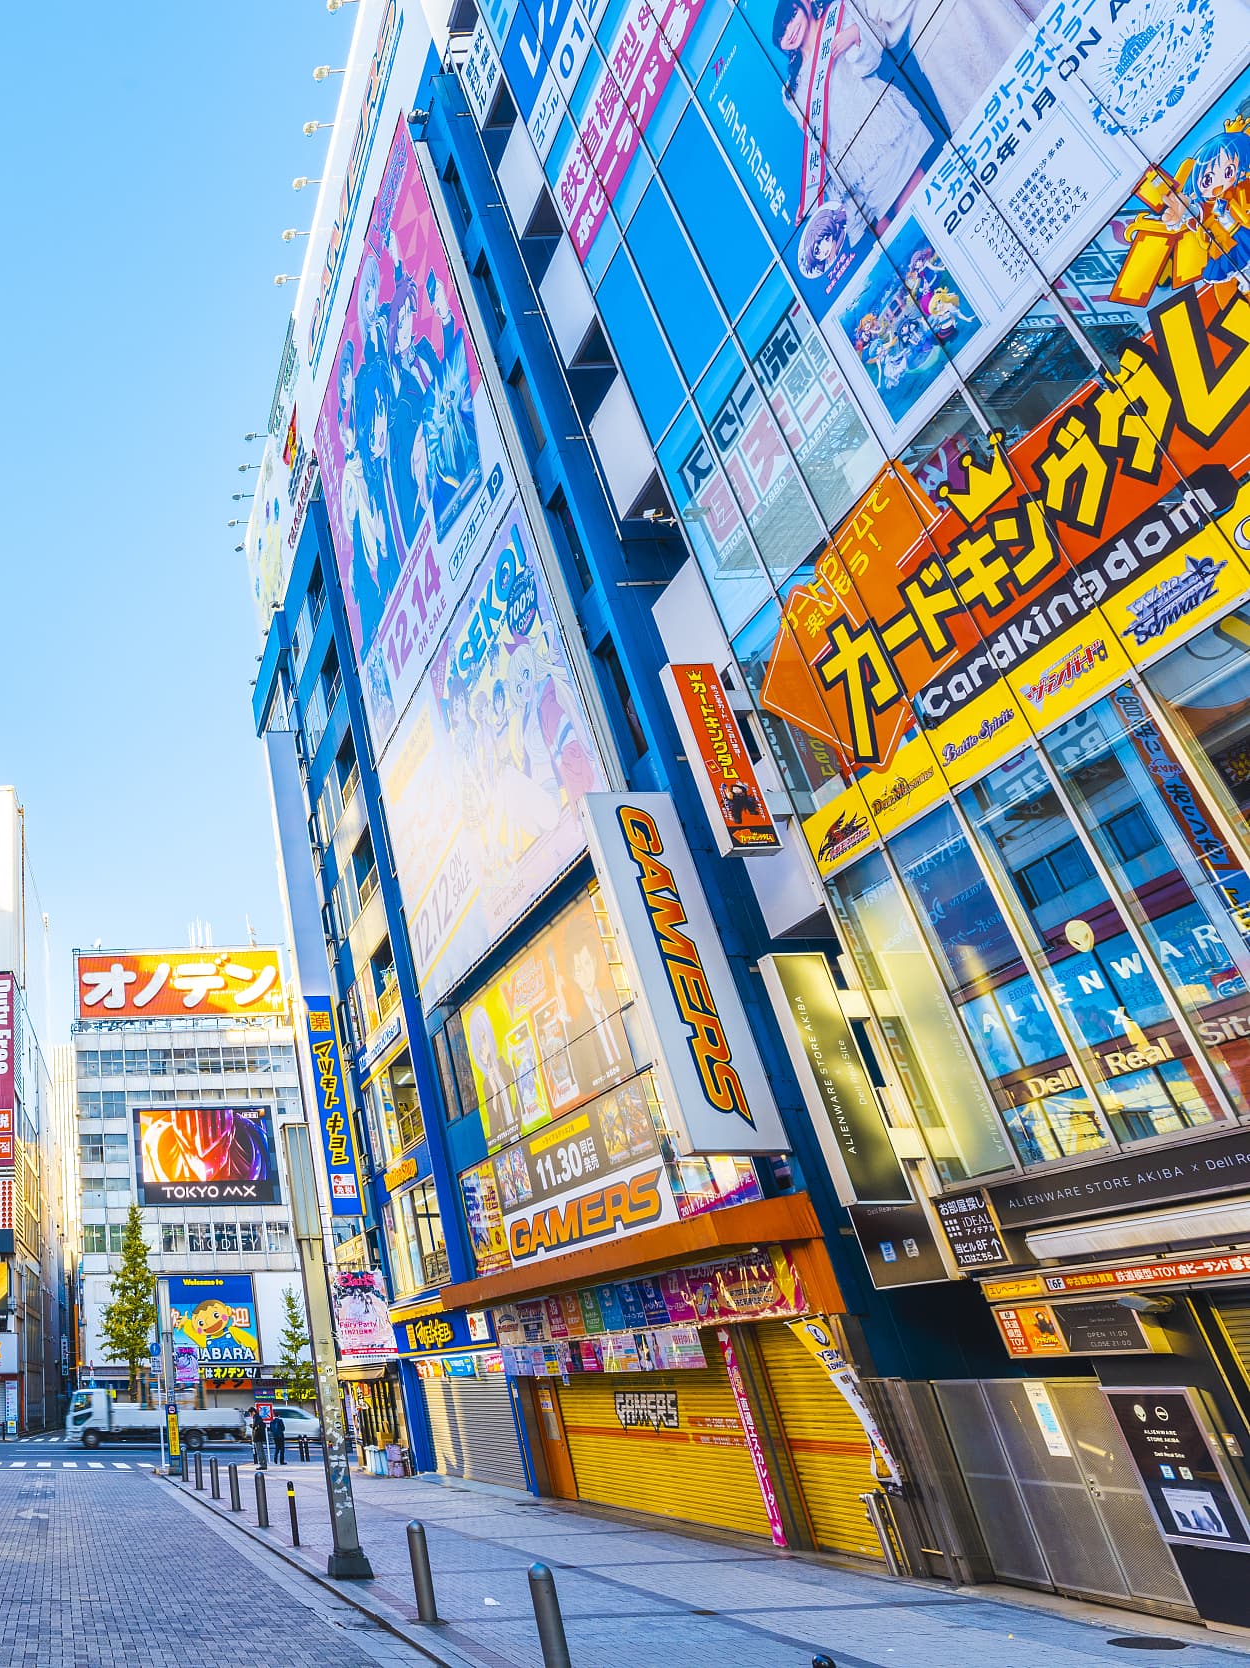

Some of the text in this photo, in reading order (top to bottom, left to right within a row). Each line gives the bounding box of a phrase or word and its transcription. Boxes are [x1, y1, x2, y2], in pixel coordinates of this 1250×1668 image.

[944, 86, 1057, 236] 2019年1月
[1058, 26, 1102, 82] ON
[386, 545, 443, 679] 12.14
[506, 578, 537, 625] 100%
[417, 597, 447, 655] ON SALE
[691, 679, 740, 780] カードキングダム
[977, 708, 1015, 741] Spirits
[451, 862, 473, 903] SALE
[414, 889, 451, 969] 12.12
[81, 952, 277, 1009] オノデン
[616, 804, 757, 1132] GAMERS
[794, 995, 857, 1154] ALIENWARE STORE AKIBA
[1025, 1067, 1080, 1099] Dell
[1105, 1037, 1175, 1075] Real
[535, 1141, 582, 1191] 11.30
[1009, 1156, 1234, 1209] ALIENWARE STORE AKIBA Dell
[161, 1185, 257, 1199] TOKYO MX
[508, 1168, 663, 1263] GAMERS
[938, 1196, 985, 1216] お部屋探し
[193, 1237, 259, 1251] MODIFY
[961, 1213, 992, 1227] iDEAL
[955, 1239, 988, 1254] 当ビル8F
[959, 1252, 994, 1264] 入口はこちら
[340, 1321, 357, 1329] Fairy
[1010, 1338, 1026, 1346] TOY
[197, 1347, 255, 1361] ABARA
